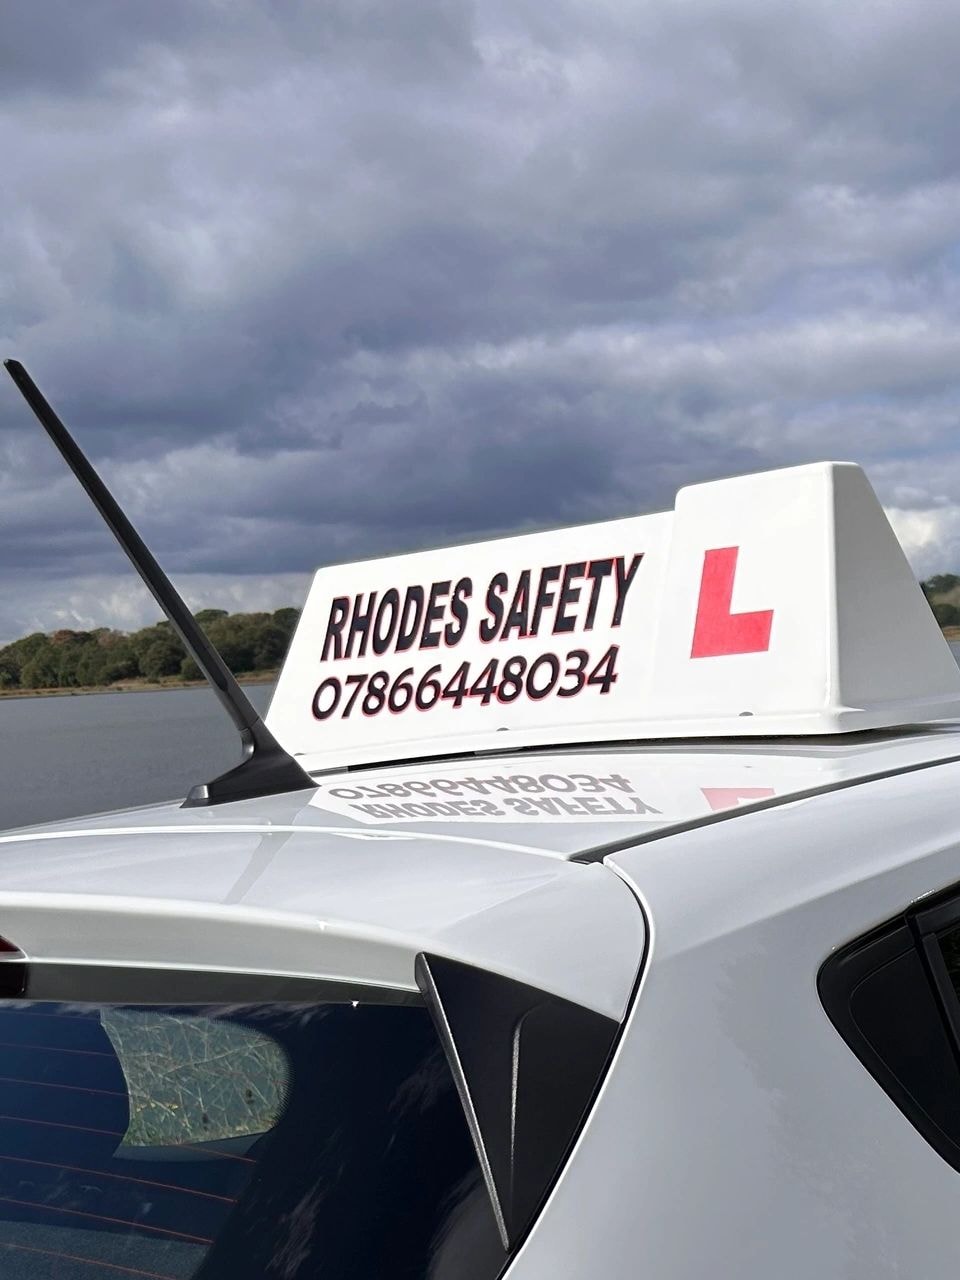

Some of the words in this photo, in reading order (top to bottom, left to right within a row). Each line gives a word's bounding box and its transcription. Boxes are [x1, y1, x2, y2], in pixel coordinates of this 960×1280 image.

[321, 577, 473, 661] RHODES
[480, 553, 645, 642] SAFETY
[691, 547, 774, 658] L
[312, 645, 619, 720] 07866448034
